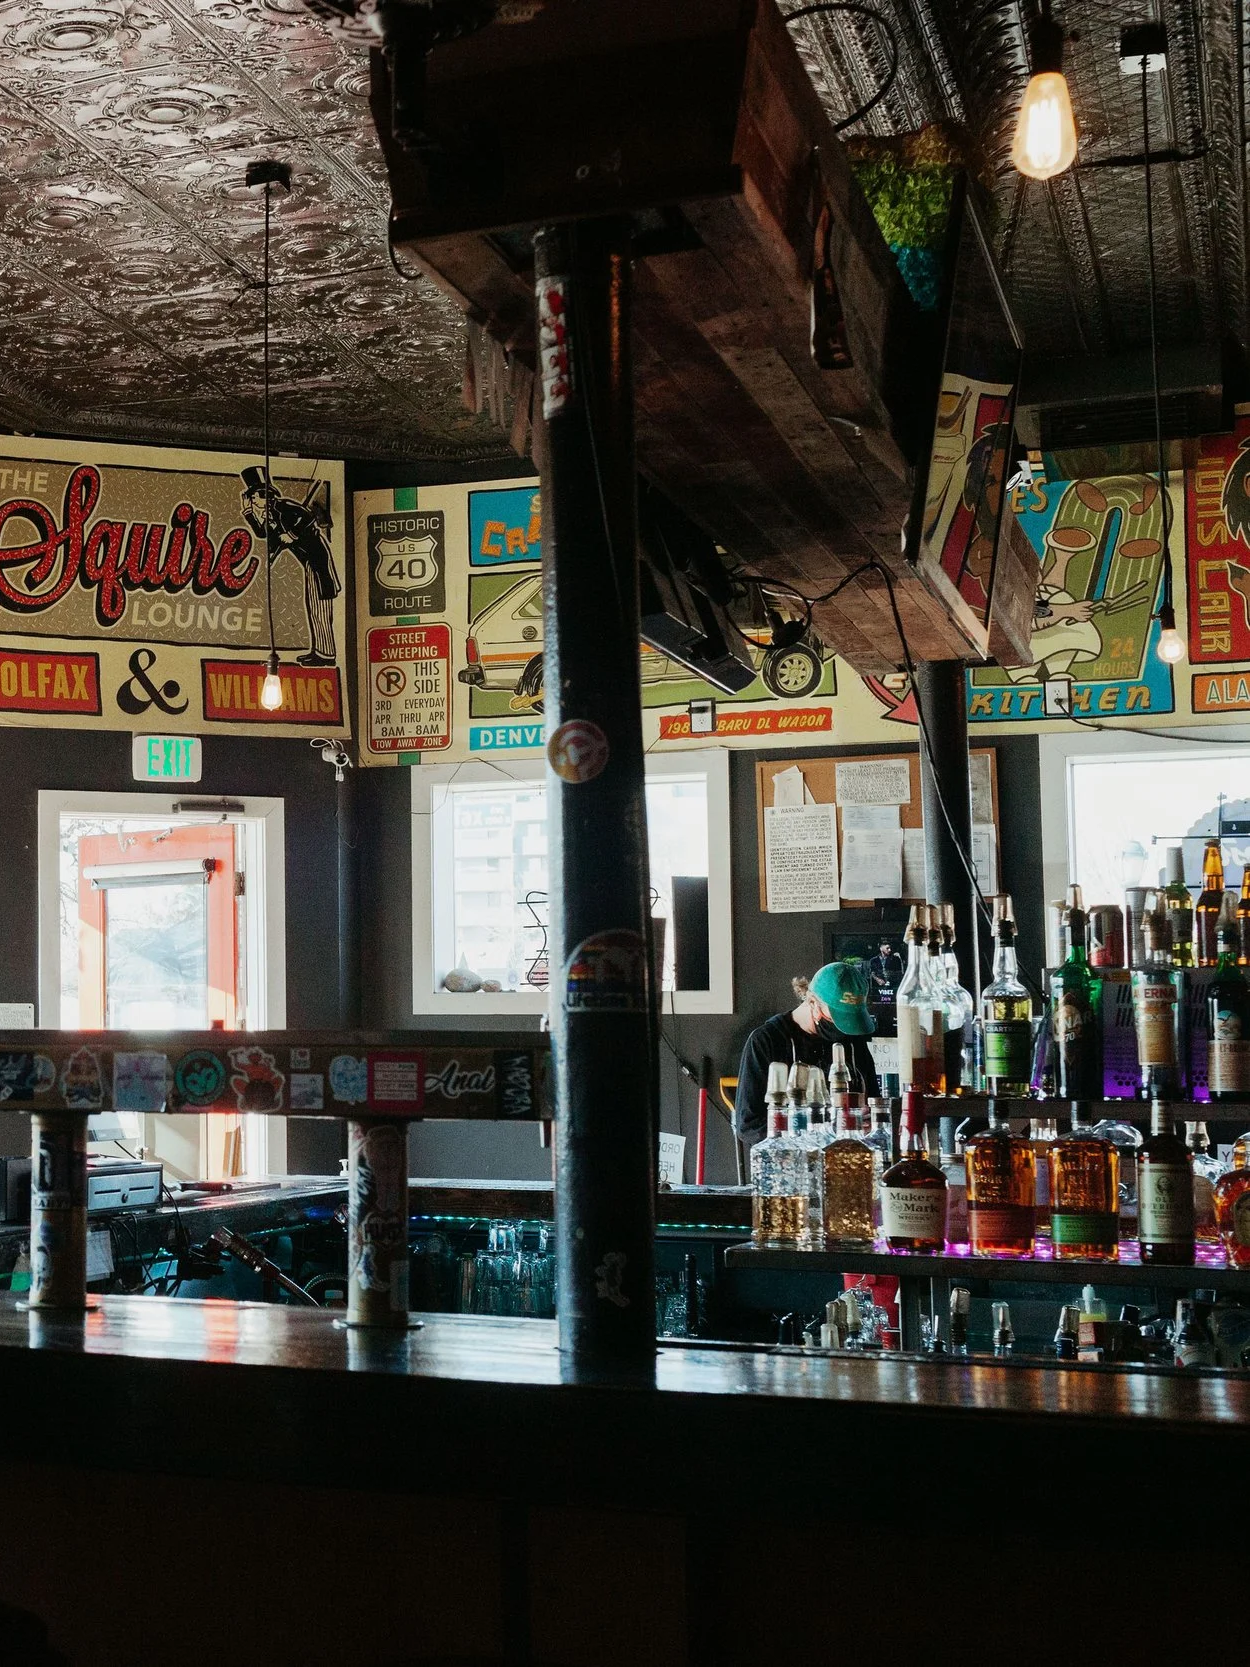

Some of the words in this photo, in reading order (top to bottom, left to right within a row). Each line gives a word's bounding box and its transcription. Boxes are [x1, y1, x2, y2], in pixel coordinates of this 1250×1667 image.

[373, 517, 440, 534] HISTORIC
[397, 543, 416, 553] US
[386, 558, 426, 580] 40
[384, 595, 432, 610] ROUTE
[132, 600, 263, 632] LOUNGE
[389, 632, 426, 646] STREET
[381, 646, 438, 660] SWEEPING
[1110, 637, 1134, 658] 24
[414, 661, 440, 677] THIS
[1092, 661, 1136, 677] HOURS
[414, 679, 441, 694] SIDE
[375, 699, 392, 711] 3RD
[404, 697, 445, 710] EVERYDAY
[970, 685, 1151, 714] KITHEN
[375, 713, 391, 725] APR
[400, 712, 422, 724] THRU
[428, 711, 445, 723] APR
[668, 722, 690, 734] 198
[716, 718, 751, 732] BARU
[756, 717, 771, 729] DL
[777, 714, 826, 728] WAGON
[381, 726, 406, 738] 8AM
[415, 725, 440, 737] 8AM
[375, 739, 392, 749] TOW
[396, 738, 417, 748] AWAY
[423, 737, 443, 747] ZONE
[147, 738, 194, 777] EXIT
[1134, 987, 1177, 999] AERNA
[904, 1203, 940, 1213] Mark
